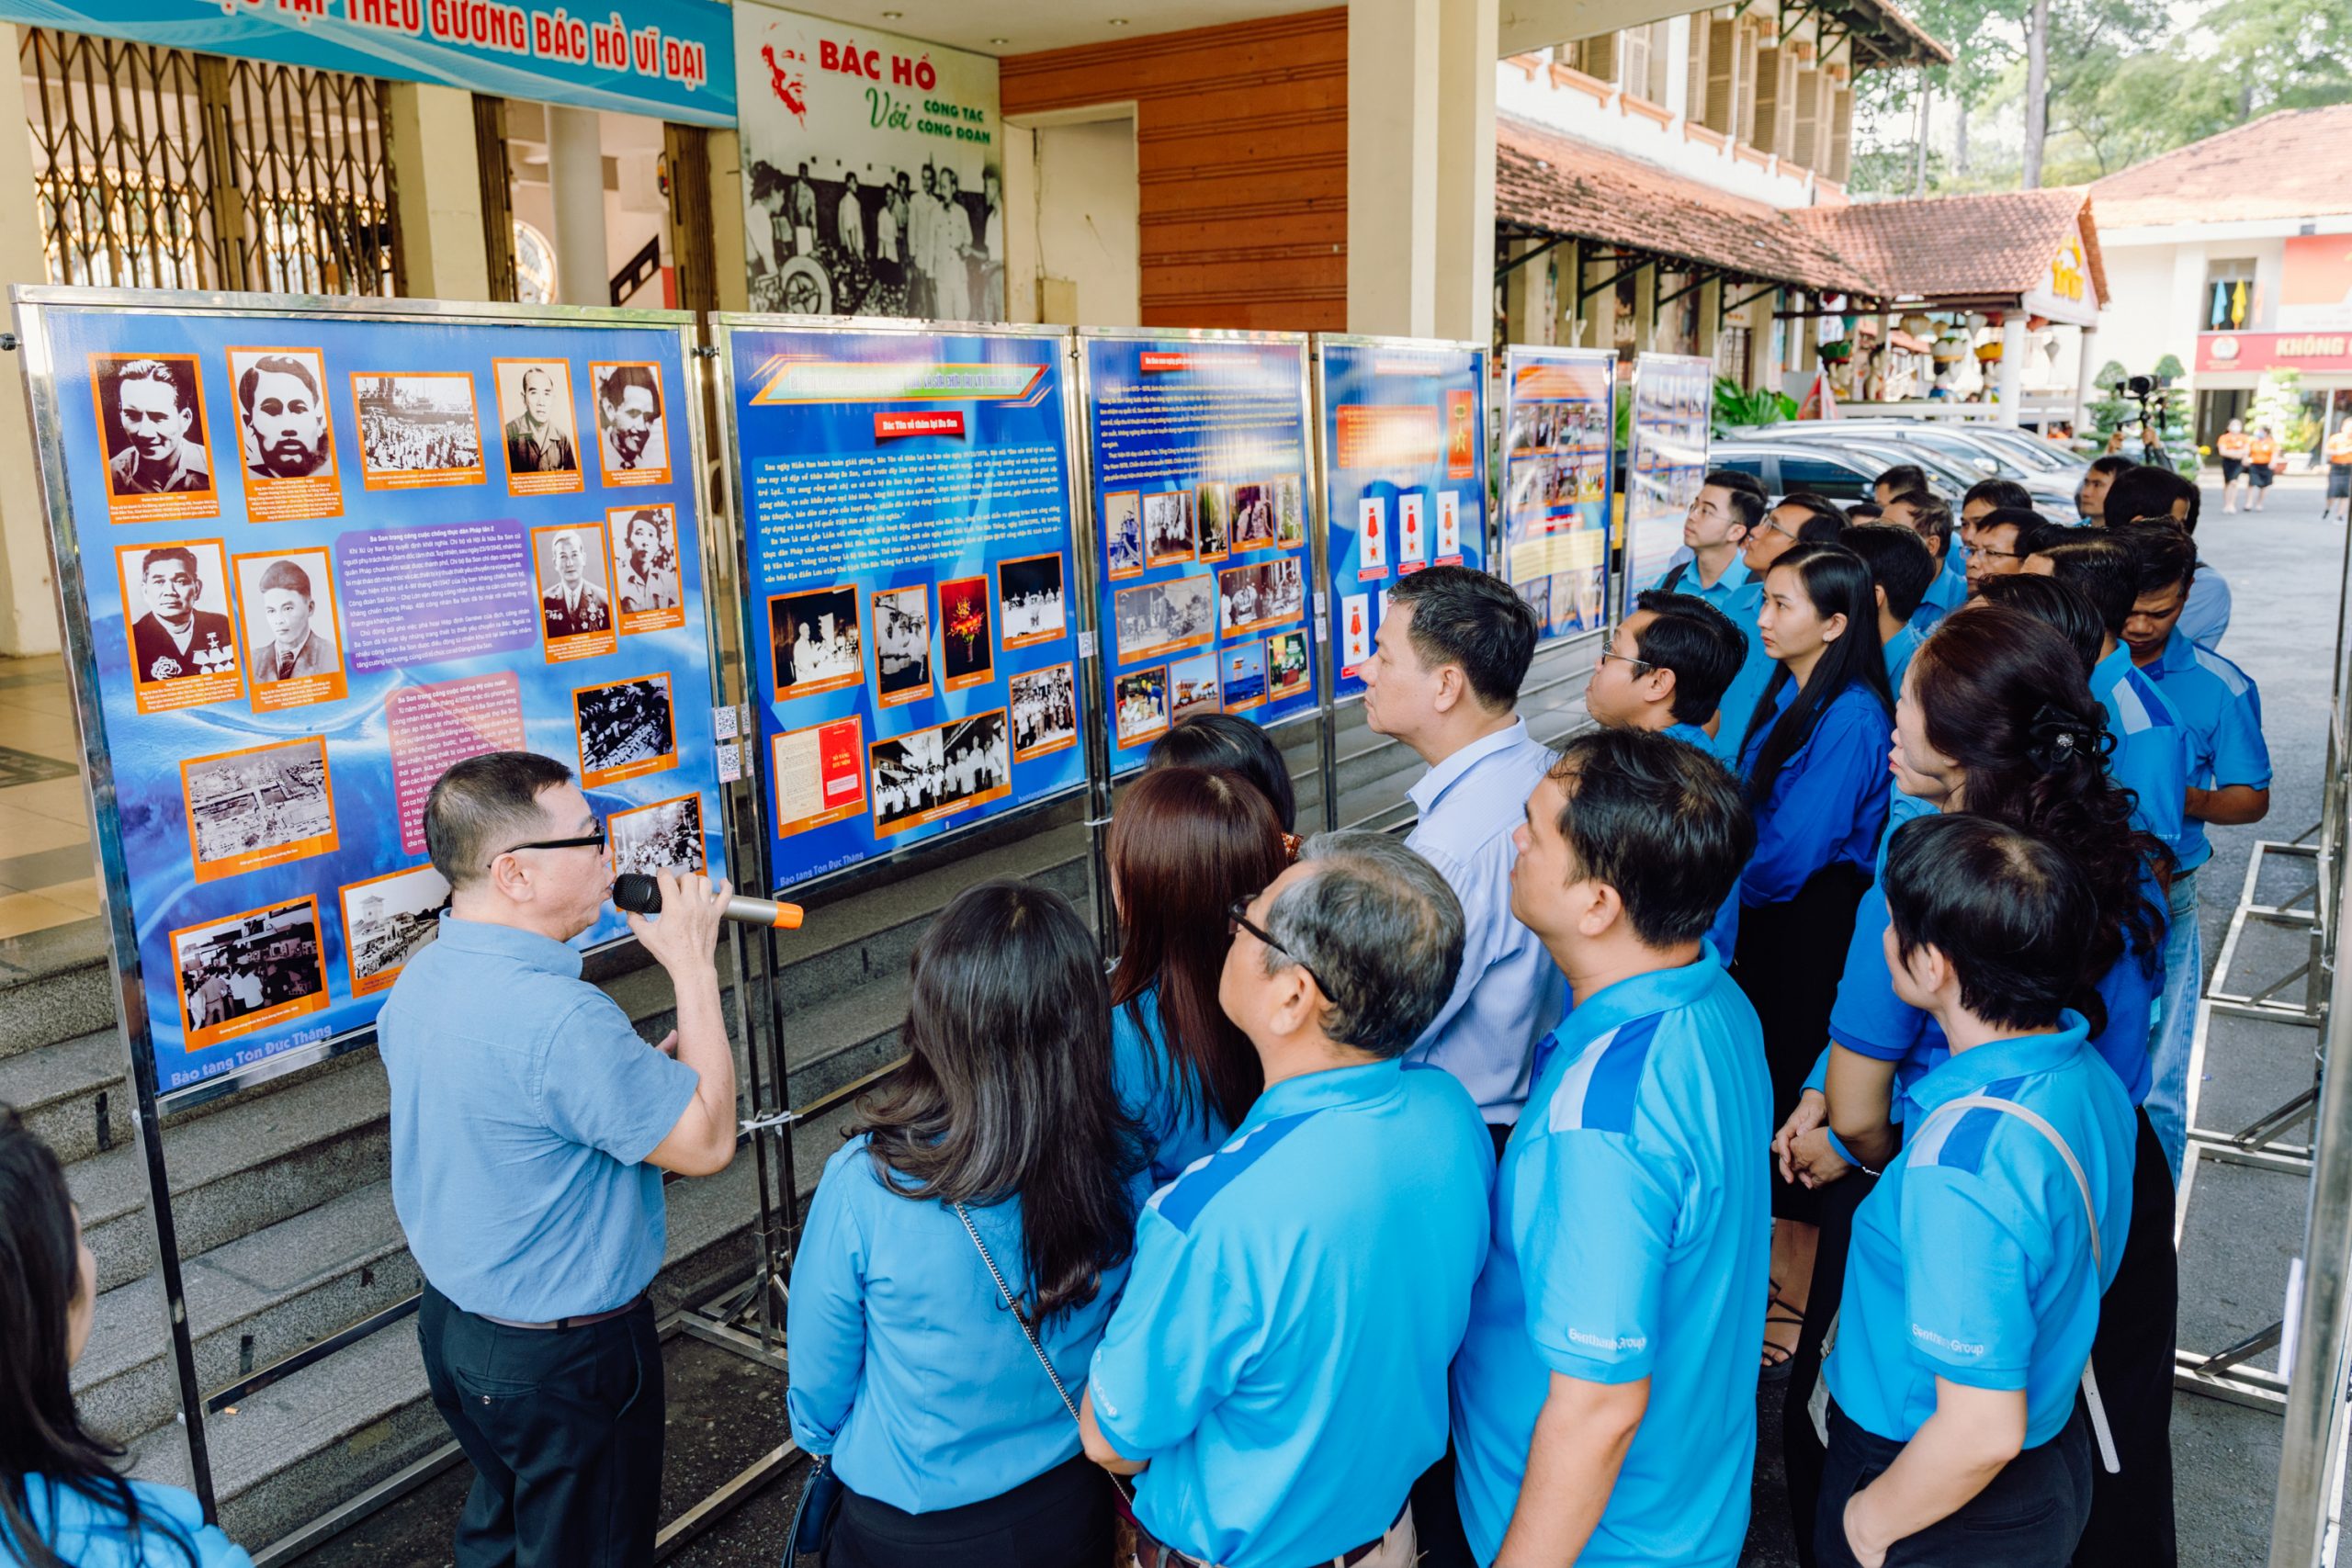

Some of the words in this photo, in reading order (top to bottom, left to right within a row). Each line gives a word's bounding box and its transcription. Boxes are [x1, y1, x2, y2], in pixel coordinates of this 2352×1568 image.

[432, 0, 526, 50] GƯƠNG
[535, 13, 586, 60] BÁC
[594, 17, 627, 67] HỒ
[634, 30, 658, 73] VĨ
[666, 41, 705, 87] ĐẠI
[820, 39, 881, 81] BÁC
[2276, 334, 2345, 357] KHÔNG
